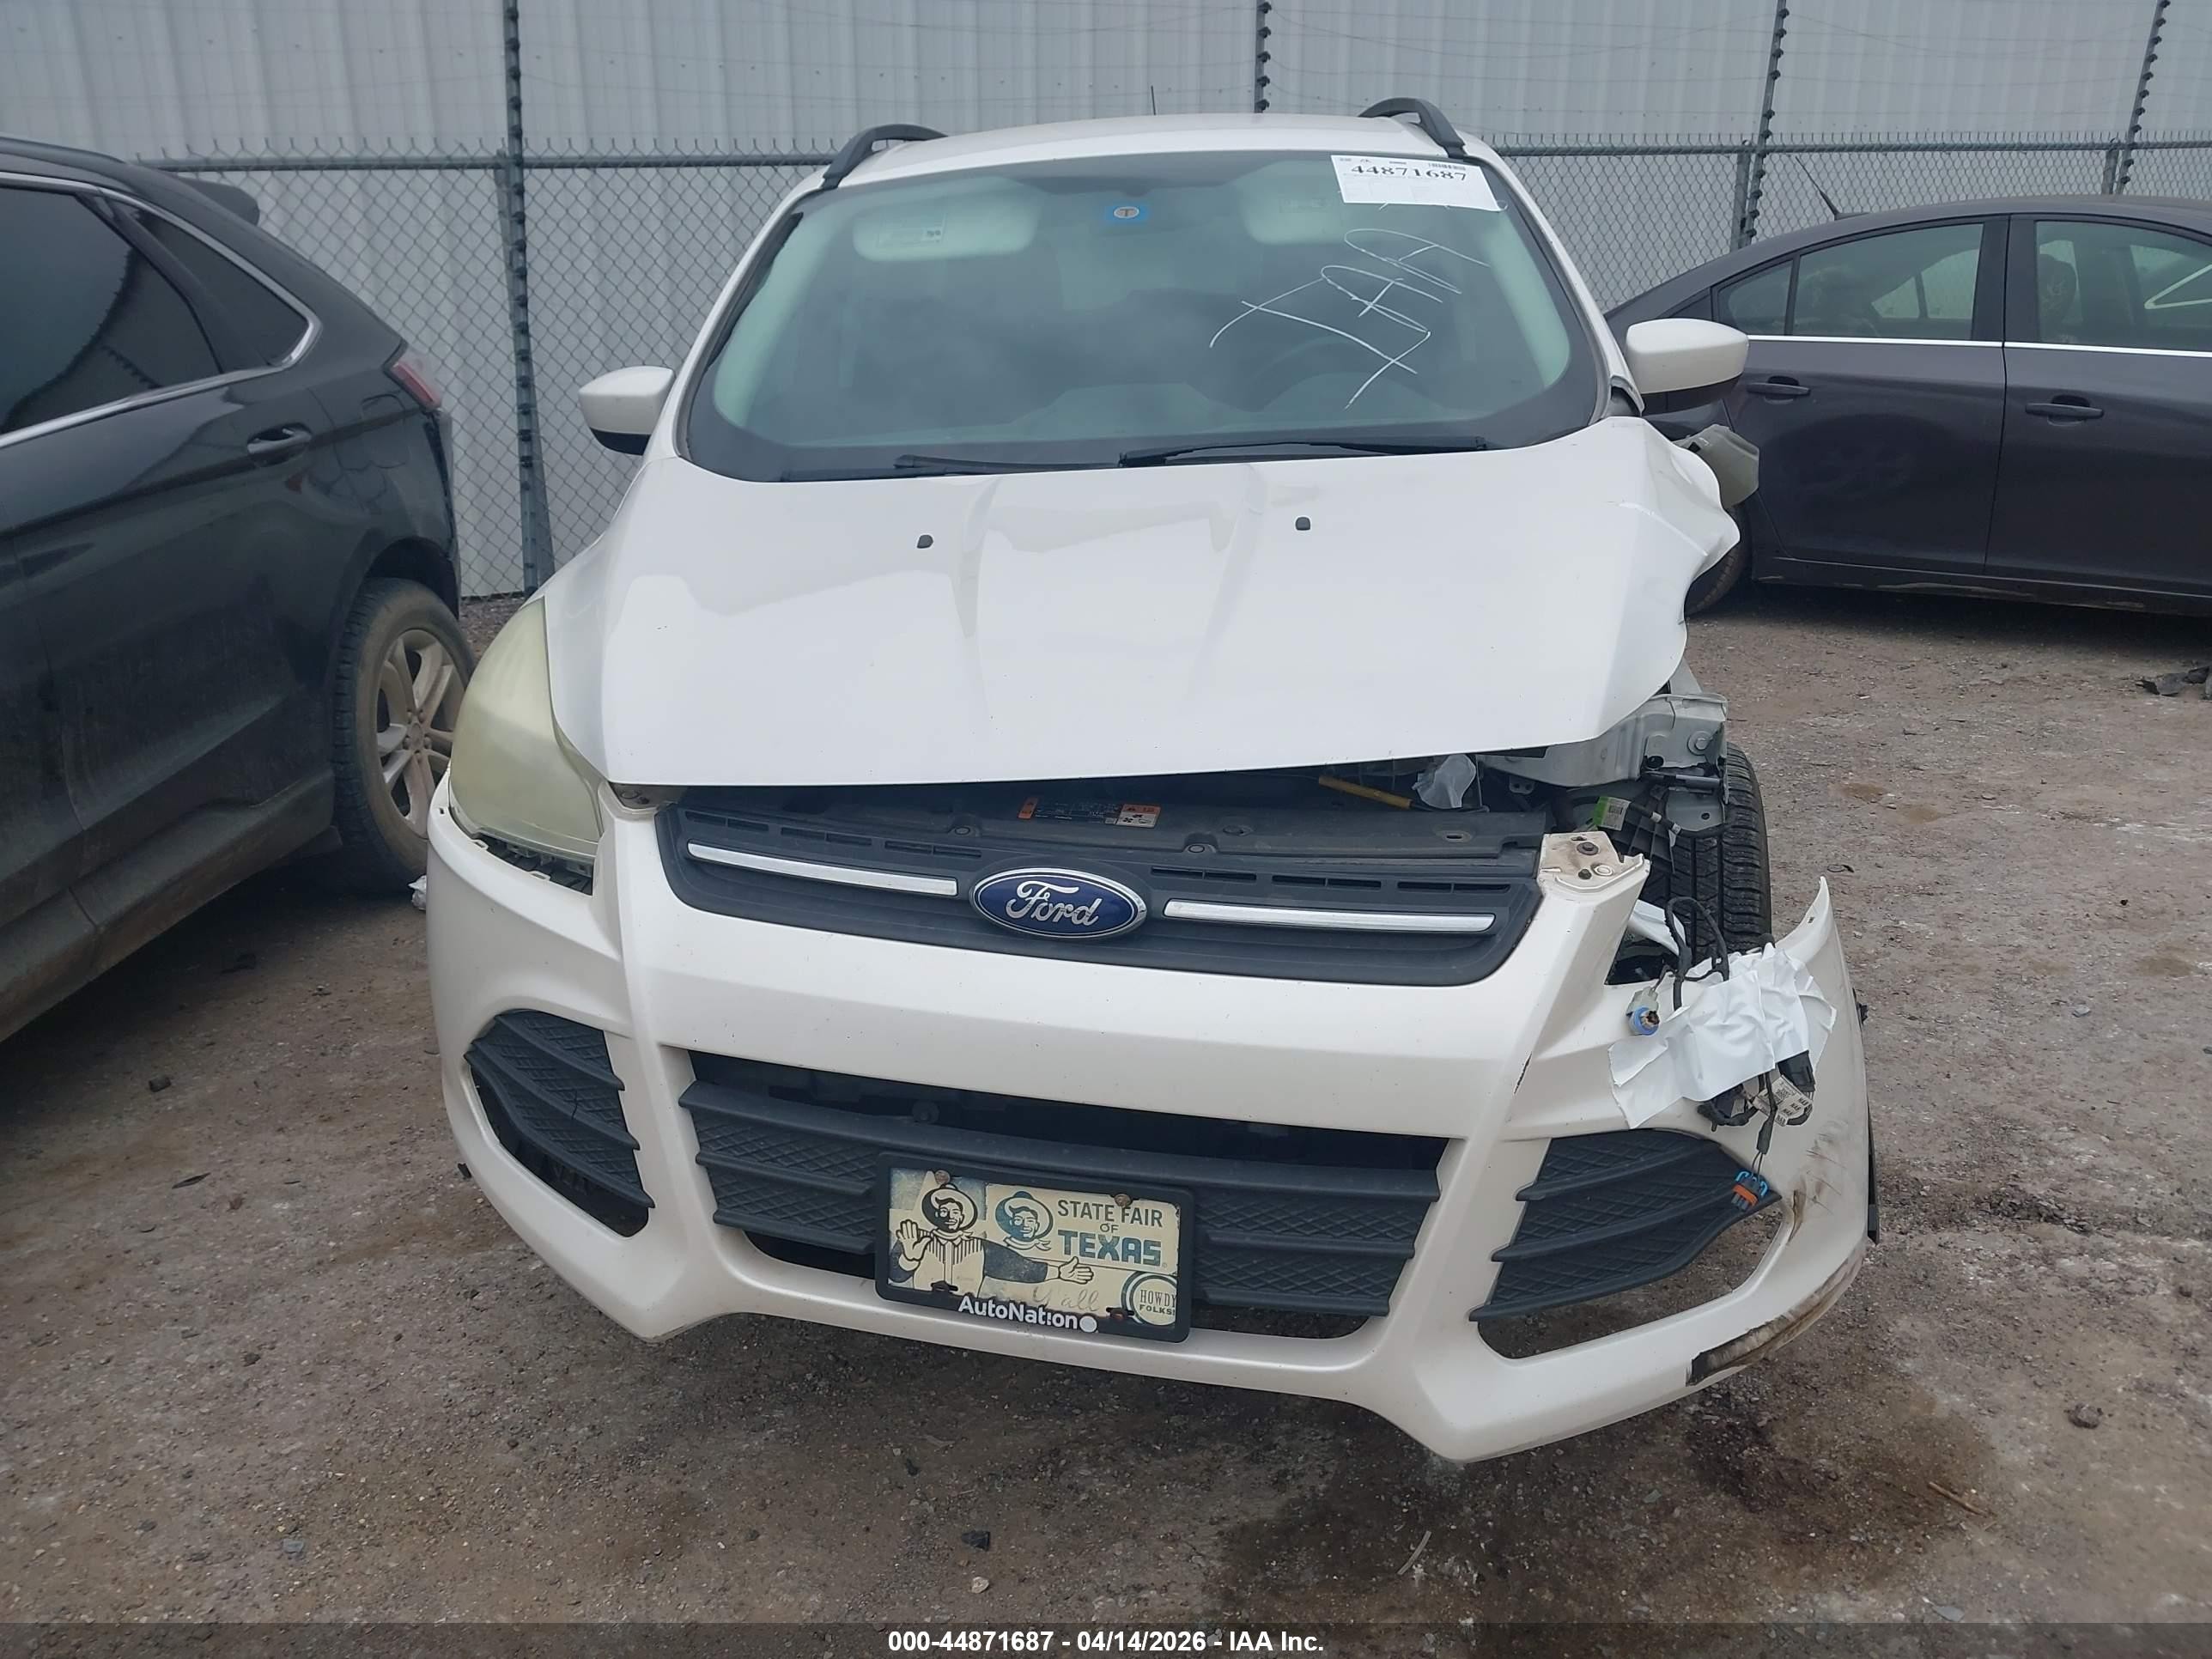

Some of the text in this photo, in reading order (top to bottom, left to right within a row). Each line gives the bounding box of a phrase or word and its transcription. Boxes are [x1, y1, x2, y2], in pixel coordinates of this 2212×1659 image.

[1352, 165, 1467, 181] 44871687
[1006, 881, 1102, 927] Ford
[1057, 1199, 1163, 1228] STATE FAIR
[1100, 1223, 1120, 1234] OF
[1057, 1229, 1162, 1267] TEXAS
[957, 1295, 1078, 1329] AutoNation
[1139, 1289, 1177, 1308] HOWDY
